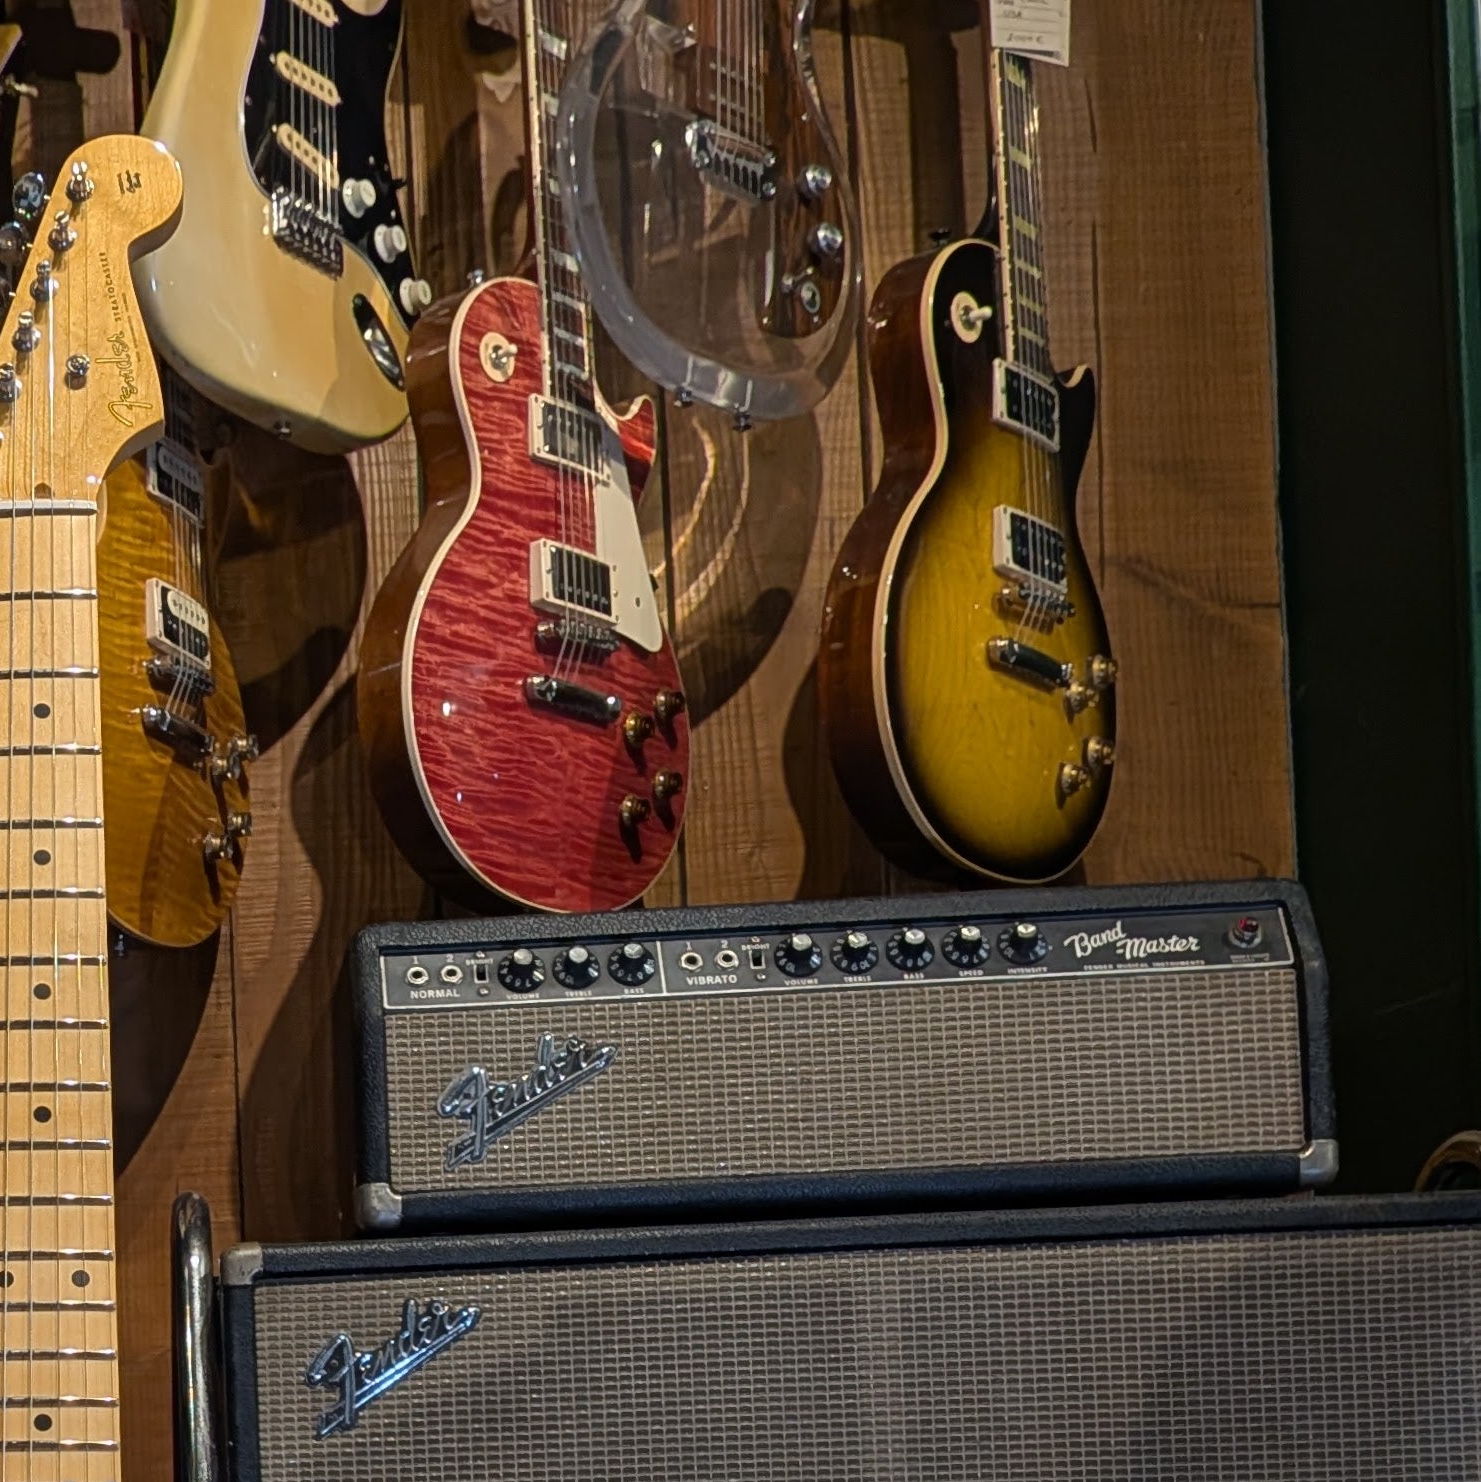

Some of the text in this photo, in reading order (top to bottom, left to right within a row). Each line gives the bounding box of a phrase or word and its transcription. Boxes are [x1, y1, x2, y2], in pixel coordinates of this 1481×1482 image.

[95, 330, 153, 427] Fender
[1063, 919, 1127, 959] Band
[686, 974, 738, 986] VIBRATO
[784, 978, 819, 987] VOLUME
[903, 972, 925, 981] BASS
[410, 988, 461, 1000] NORMAL
[506, 992, 540, 1001] VOLUME
[623, 987, 645, 995] BASS
[437, 1030, 619, 1172] Fender
[305, 1297, 482, 1440] Fender
